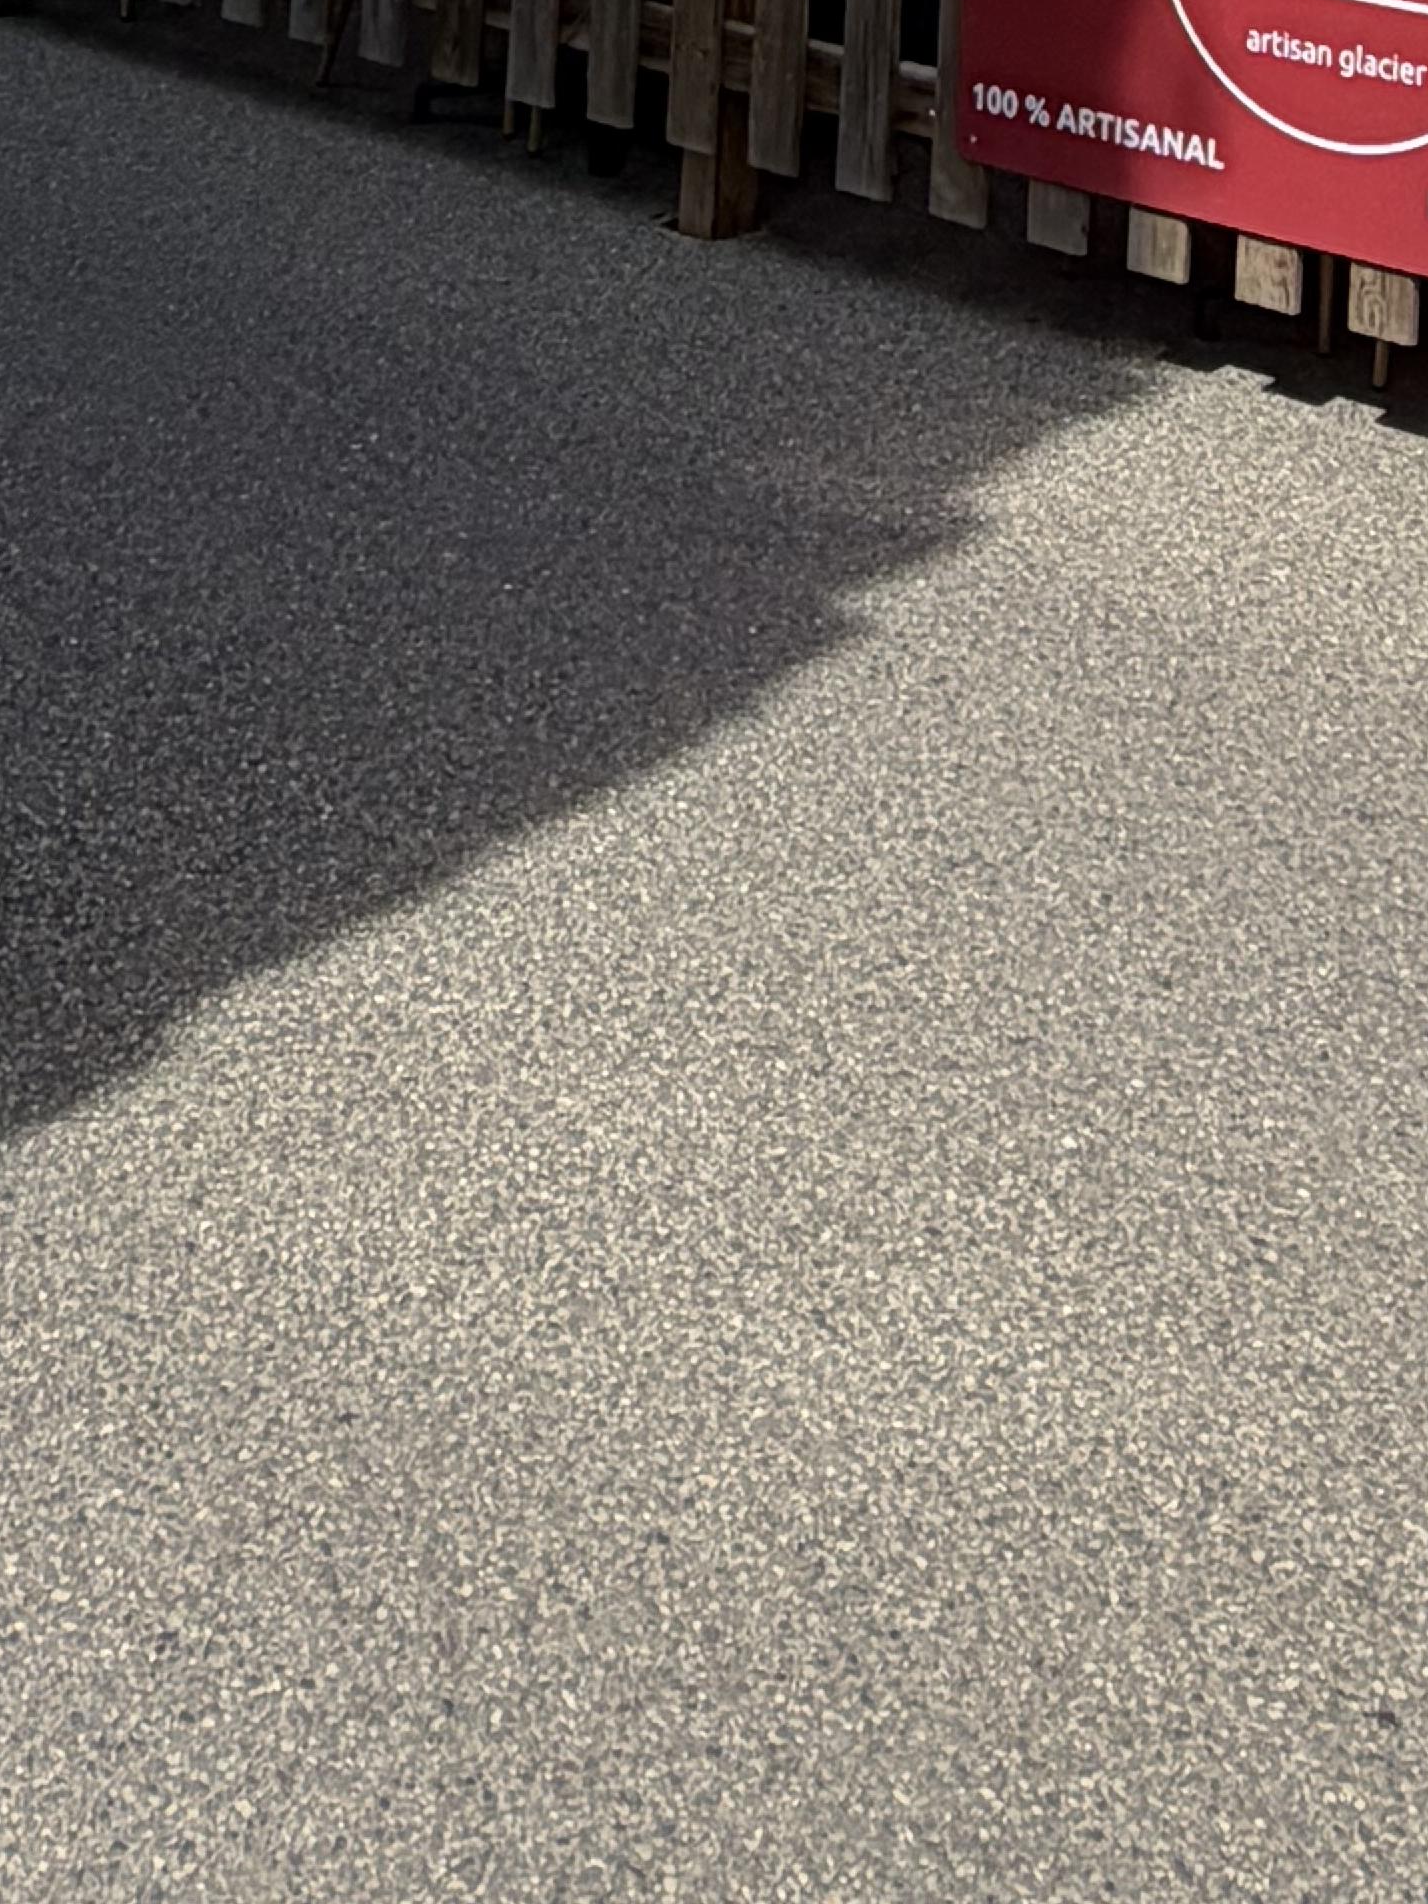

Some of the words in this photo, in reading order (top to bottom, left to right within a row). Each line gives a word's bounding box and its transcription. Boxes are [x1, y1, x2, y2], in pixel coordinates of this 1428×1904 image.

[1245, 28, 1333, 68] artisan
[1338, 44, 1428, 87] glacier
[971, 81, 1019, 120] 100
[1024, 93, 1051, 128] %
[1055, 103, 1226, 171] ARTISANAL
